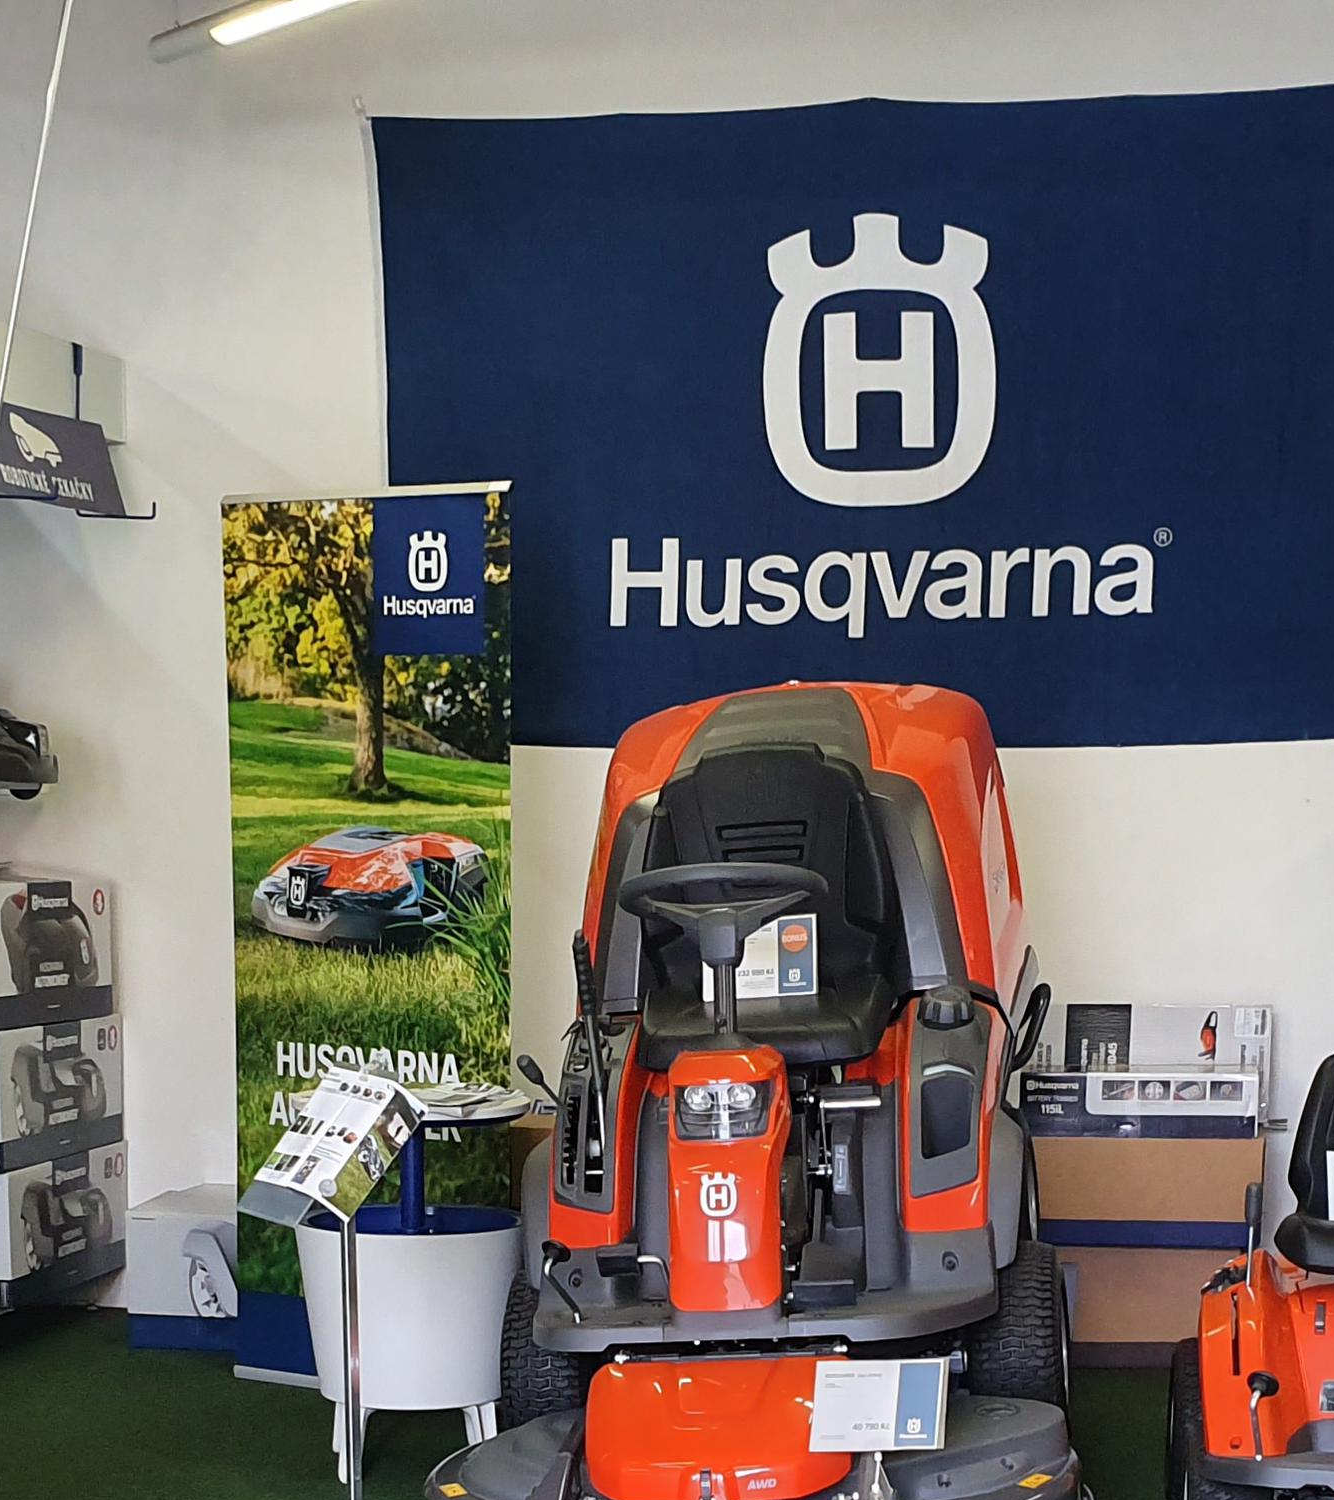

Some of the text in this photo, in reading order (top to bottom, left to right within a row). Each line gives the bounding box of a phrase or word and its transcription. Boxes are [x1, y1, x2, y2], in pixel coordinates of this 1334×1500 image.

[382, 593, 477, 617] Husqvarna
[1036, 1080, 1080, 1091] Husqvarna
[747, 1478, 777, 1491] AWD
